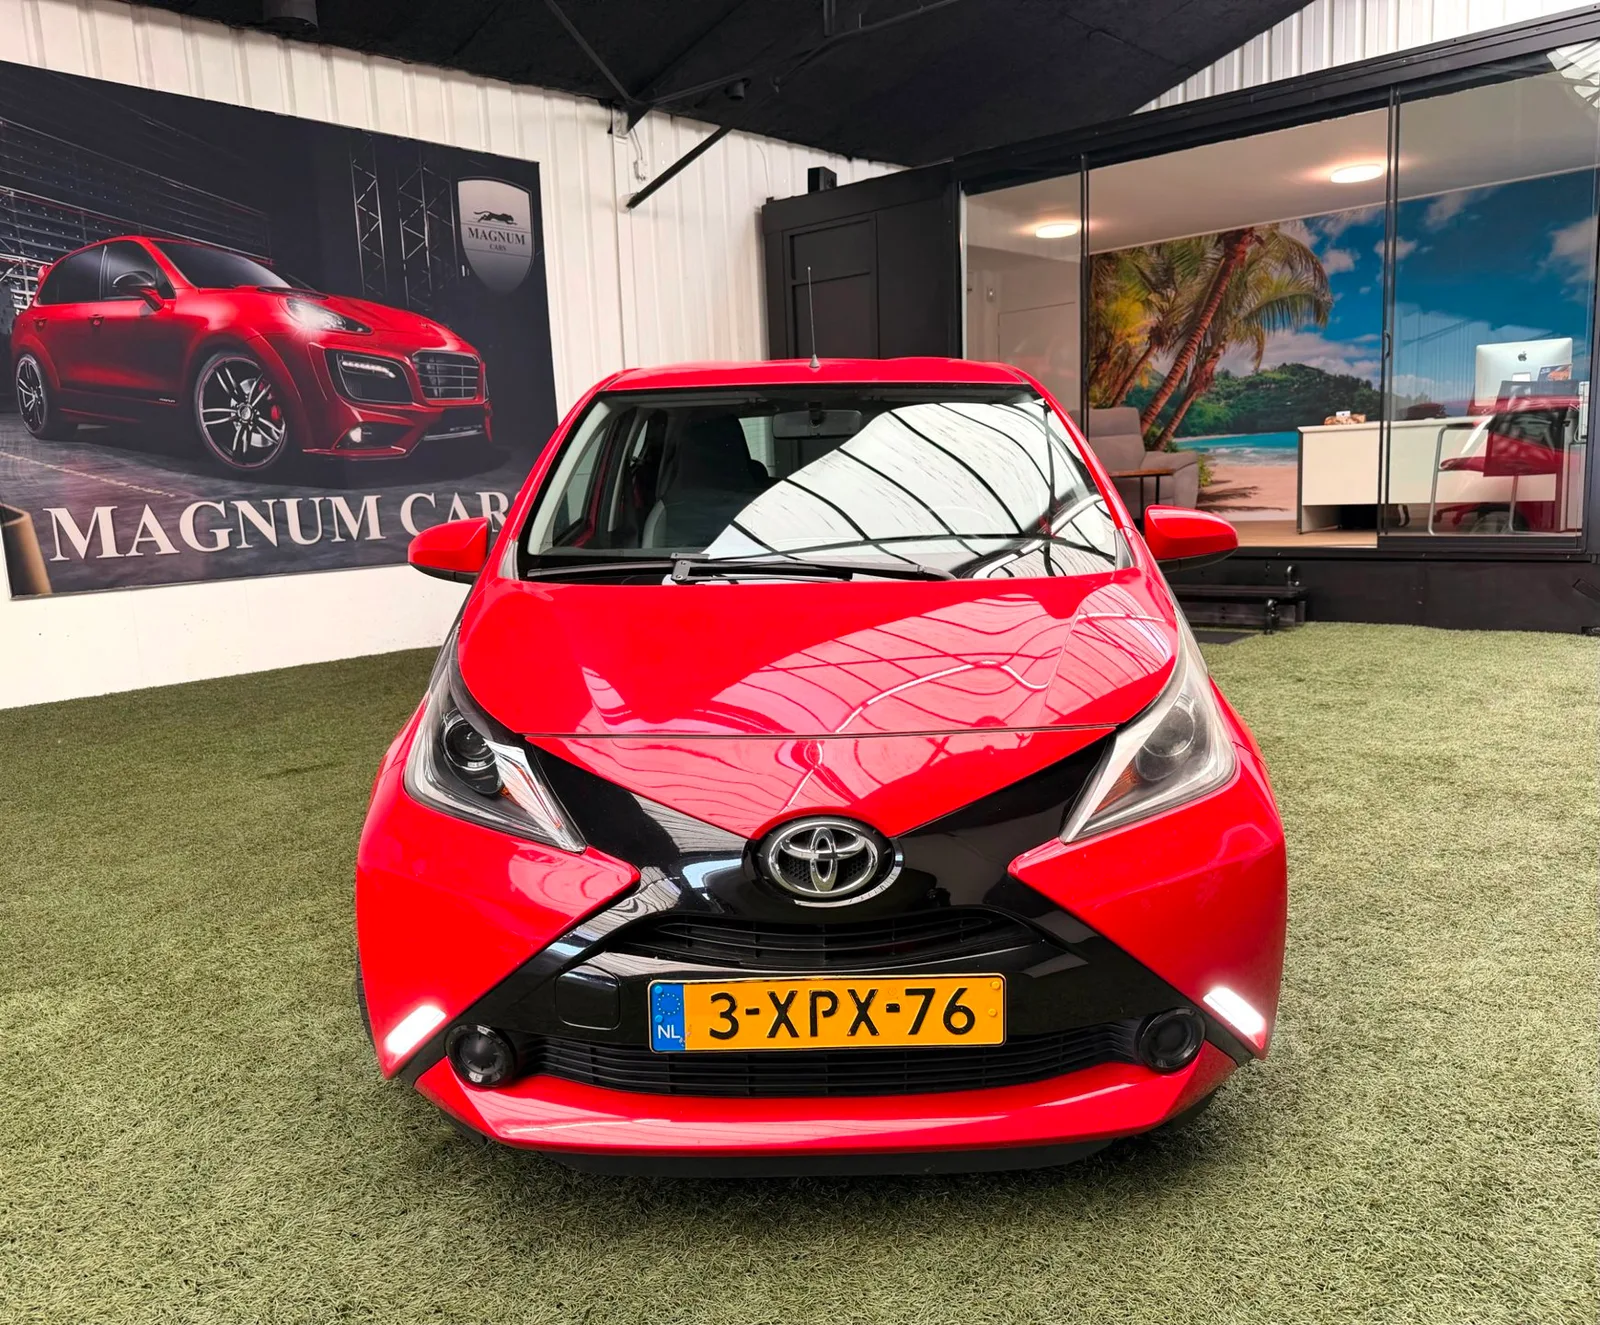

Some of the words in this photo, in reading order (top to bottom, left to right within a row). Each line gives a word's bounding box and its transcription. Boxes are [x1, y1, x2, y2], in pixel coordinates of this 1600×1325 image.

[468, 227, 526, 246] MAGNUM
[489, 243, 507, 252] CARS
[43, 495, 387, 562] MAGNUM
[400, 491, 520, 537] CAR
[709, 987, 976, 1040] 3-XPX-76
[657, 1024, 681, 1039] NL
